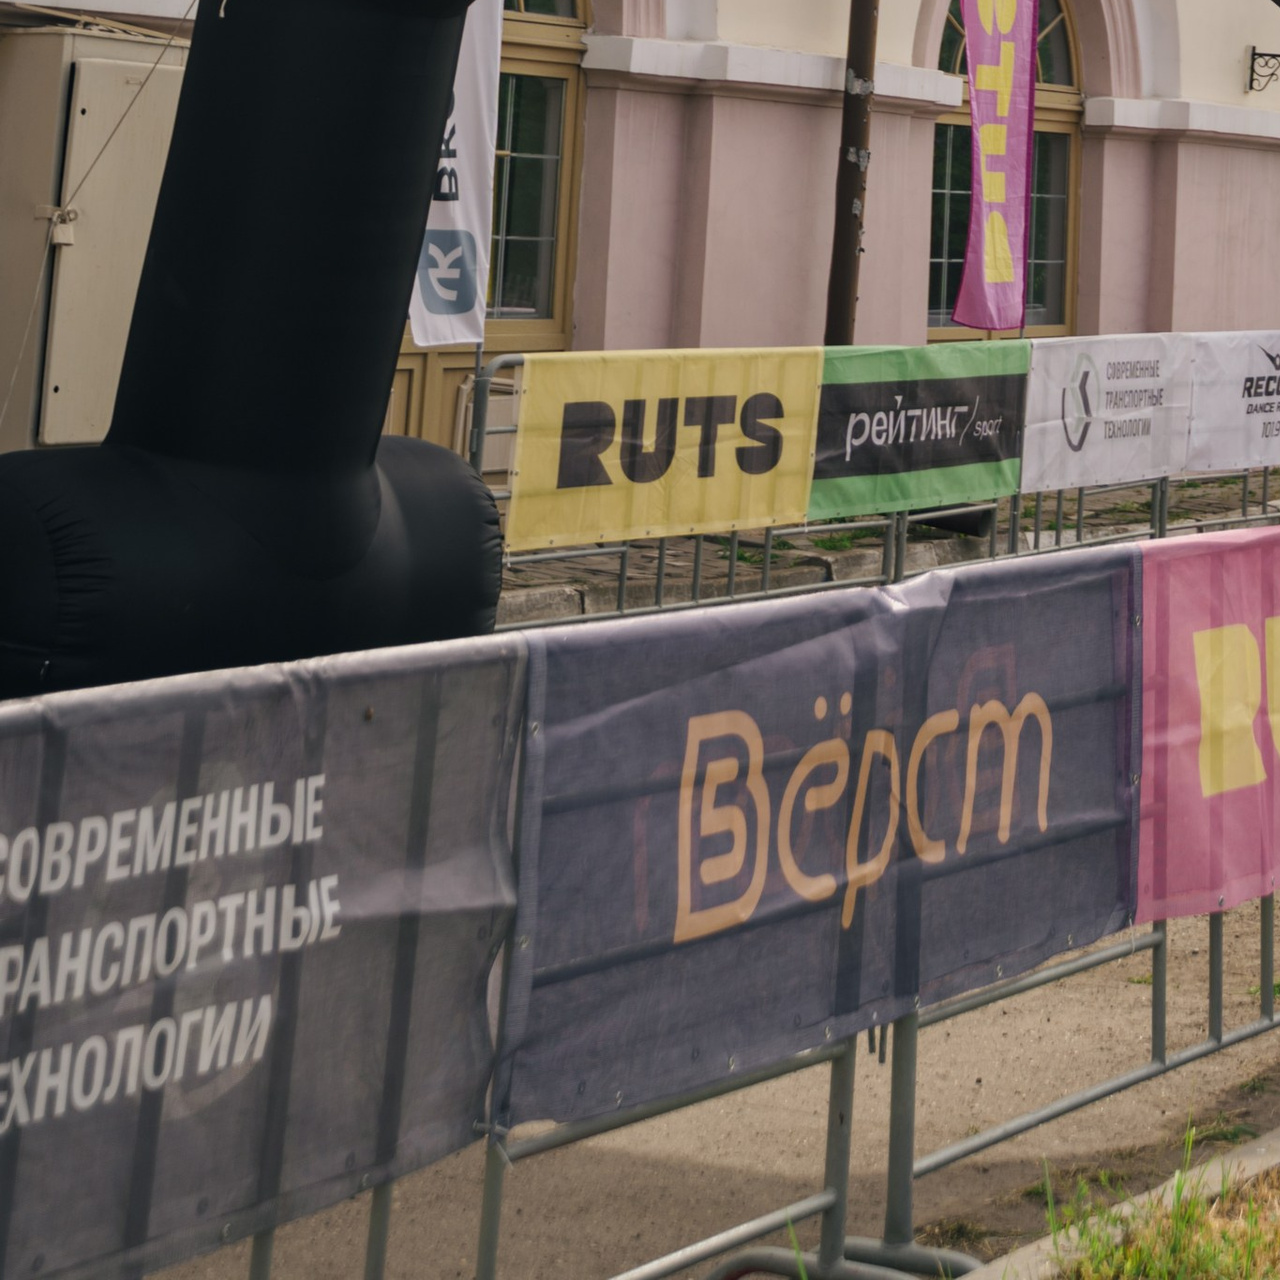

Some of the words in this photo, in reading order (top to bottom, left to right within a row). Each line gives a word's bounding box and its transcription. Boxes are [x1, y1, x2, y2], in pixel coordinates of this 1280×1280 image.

[1106, 360, 1160, 381] СОВРЕМЕННЫЕ
[1105, 388, 1164, 410] ТРАНСПОРТНЫЕ
[1246, 402, 1275, 415] DANCE
[1103, 418, 1152, 439] ТЕХНОЛОГИИ
[556, 392, 784, 489] RUTS
[0, 874, 343, 1018] РАНСПОРТНЫЕ
